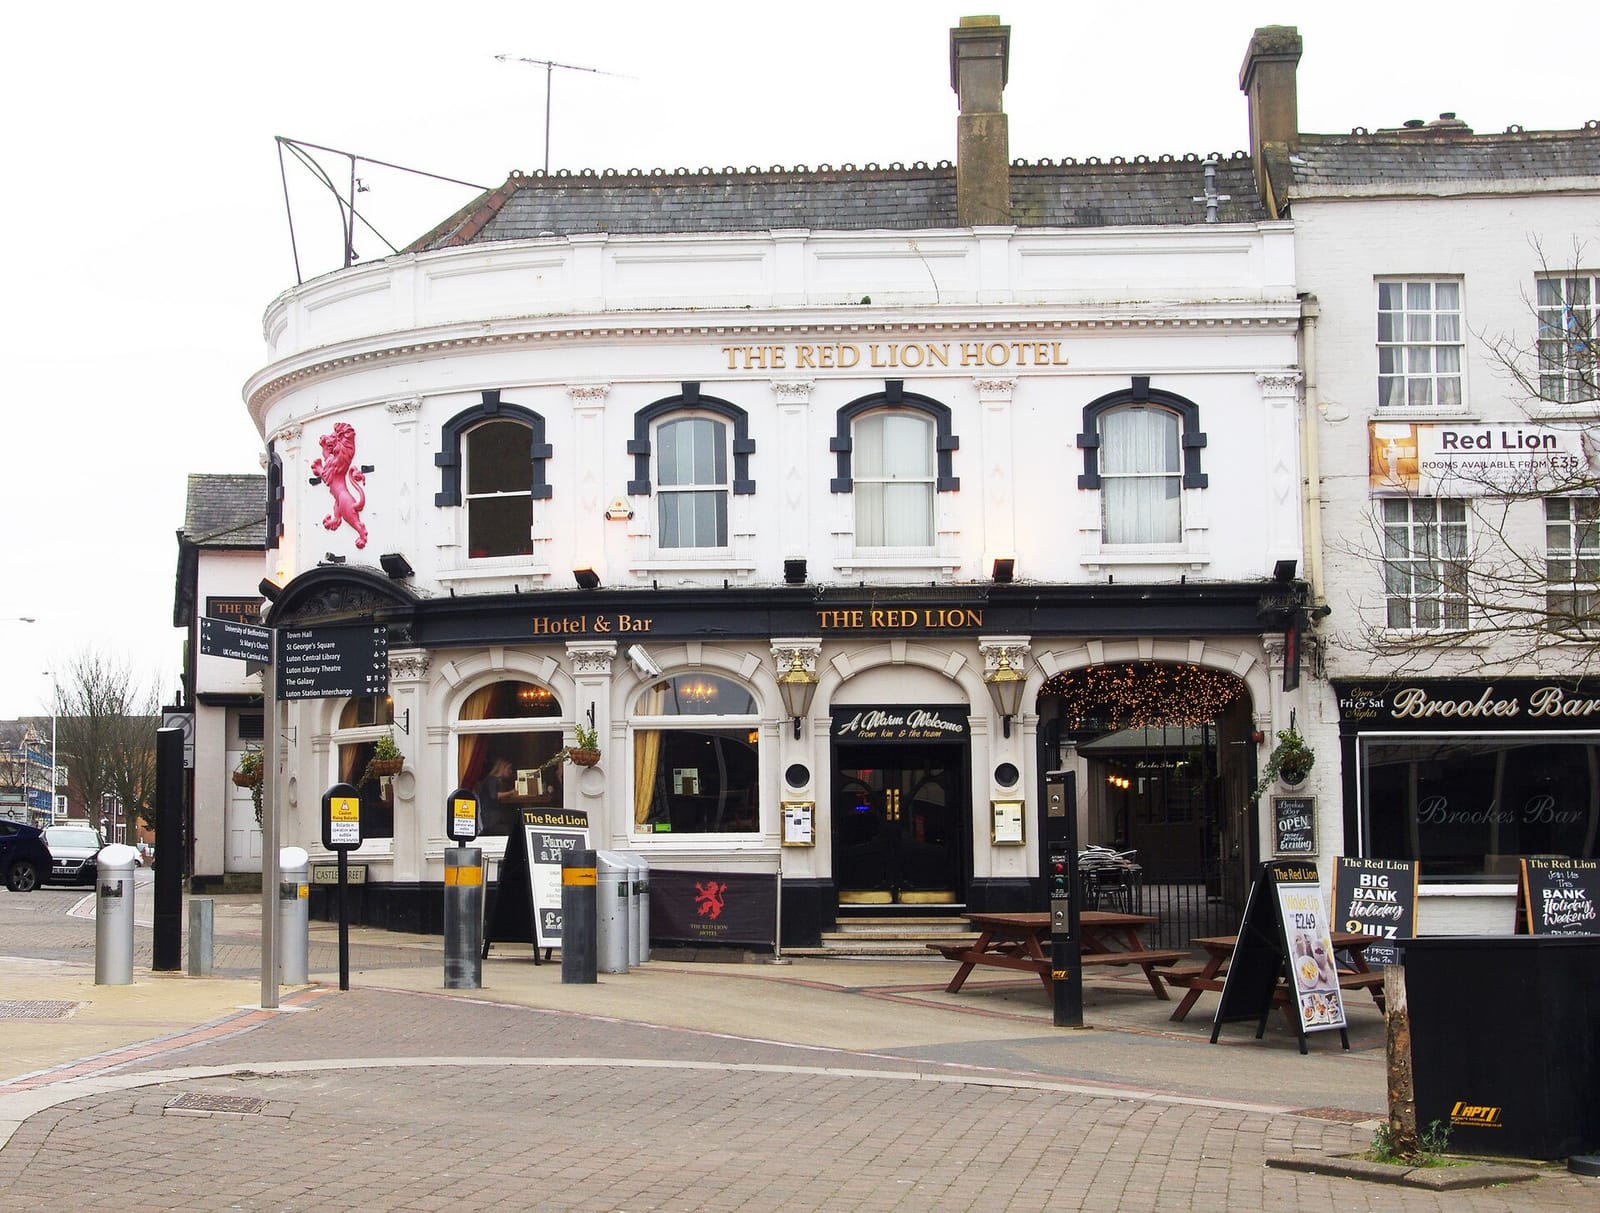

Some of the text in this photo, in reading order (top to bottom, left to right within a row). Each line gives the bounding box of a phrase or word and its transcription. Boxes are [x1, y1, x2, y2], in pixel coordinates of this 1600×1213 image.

[722, 341, 1069, 369] THE RED LION HOTEL
[1442, 430, 1557, 450] Red Lion
[1422, 456, 1579, 469] ROOMS AVAILABLE FROM £35
[217, 604, 260, 614] THE RE
[532, 614, 653, 635] Hotel & Bar
[816, 609, 984, 629] THE RED LION
[225, 625, 242, 635] University
[248, 628, 269, 638] Bedfordshire
[257, 642, 269, 650] Church
[292, 642, 316, 651] George's
[316, 642, 336, 650] Square
[229, 649, 240, 657] Centre
[247, 652, 260, 660] Carnival
[302, 653, 321, 661] Central
[321, 653, 341, 662] Library
[302, 665, 321, 674] Library
[321, 664, 341, 672] Theatre
[296, 677, 315, 686] Galaxy
[301, 689, 320, 697] Station
[321, 687, 353, 697] Interchange
[1351, 687, 1374, 700] Open
[1340, 697, 1385, 709] Fri & Sat
[1391, 686, 1600, 719] Brookes Bar
[1345, 708, 1377, 720] Nights
[837, 709, 963, 735] A Warm Welcome
[898, 729, 906, 738] &
[909, 729, 921, 737] the
[922, 729, 942, 737] team
[1415, 794, 1583, 825] Brookes Bar
[524, 812, 587, 826] The Red Lion
[1279, 815, 1309, 831] OPEN
[541, 834, 577, 850] Fancy
[540, 851, 549, 861] a
[1342, 858, 1409, 871] The Red Lion
[1529, 859, 1597, 869] The Red Lion
[316, 870, 338, 880] CASTLE
[1273, 868, 1318, 880] The Red Lion
[1359, 873, 1389, 888] BIG
[1548, 870, 1565, 880] Join
[1556, 879, 1573, 887] This
[1353, 887, 1398, 902] BANK
[1542, 889, 1586, 899] BANK
[1348, 901, 1405, 921] Holiday
[1542, 898, 1592, 914] Holiday
[545, 911, 562, 930] £2
[1295, 913, 1316, 929] £2.49
[1542, 907, 1596, 926] Weekend
